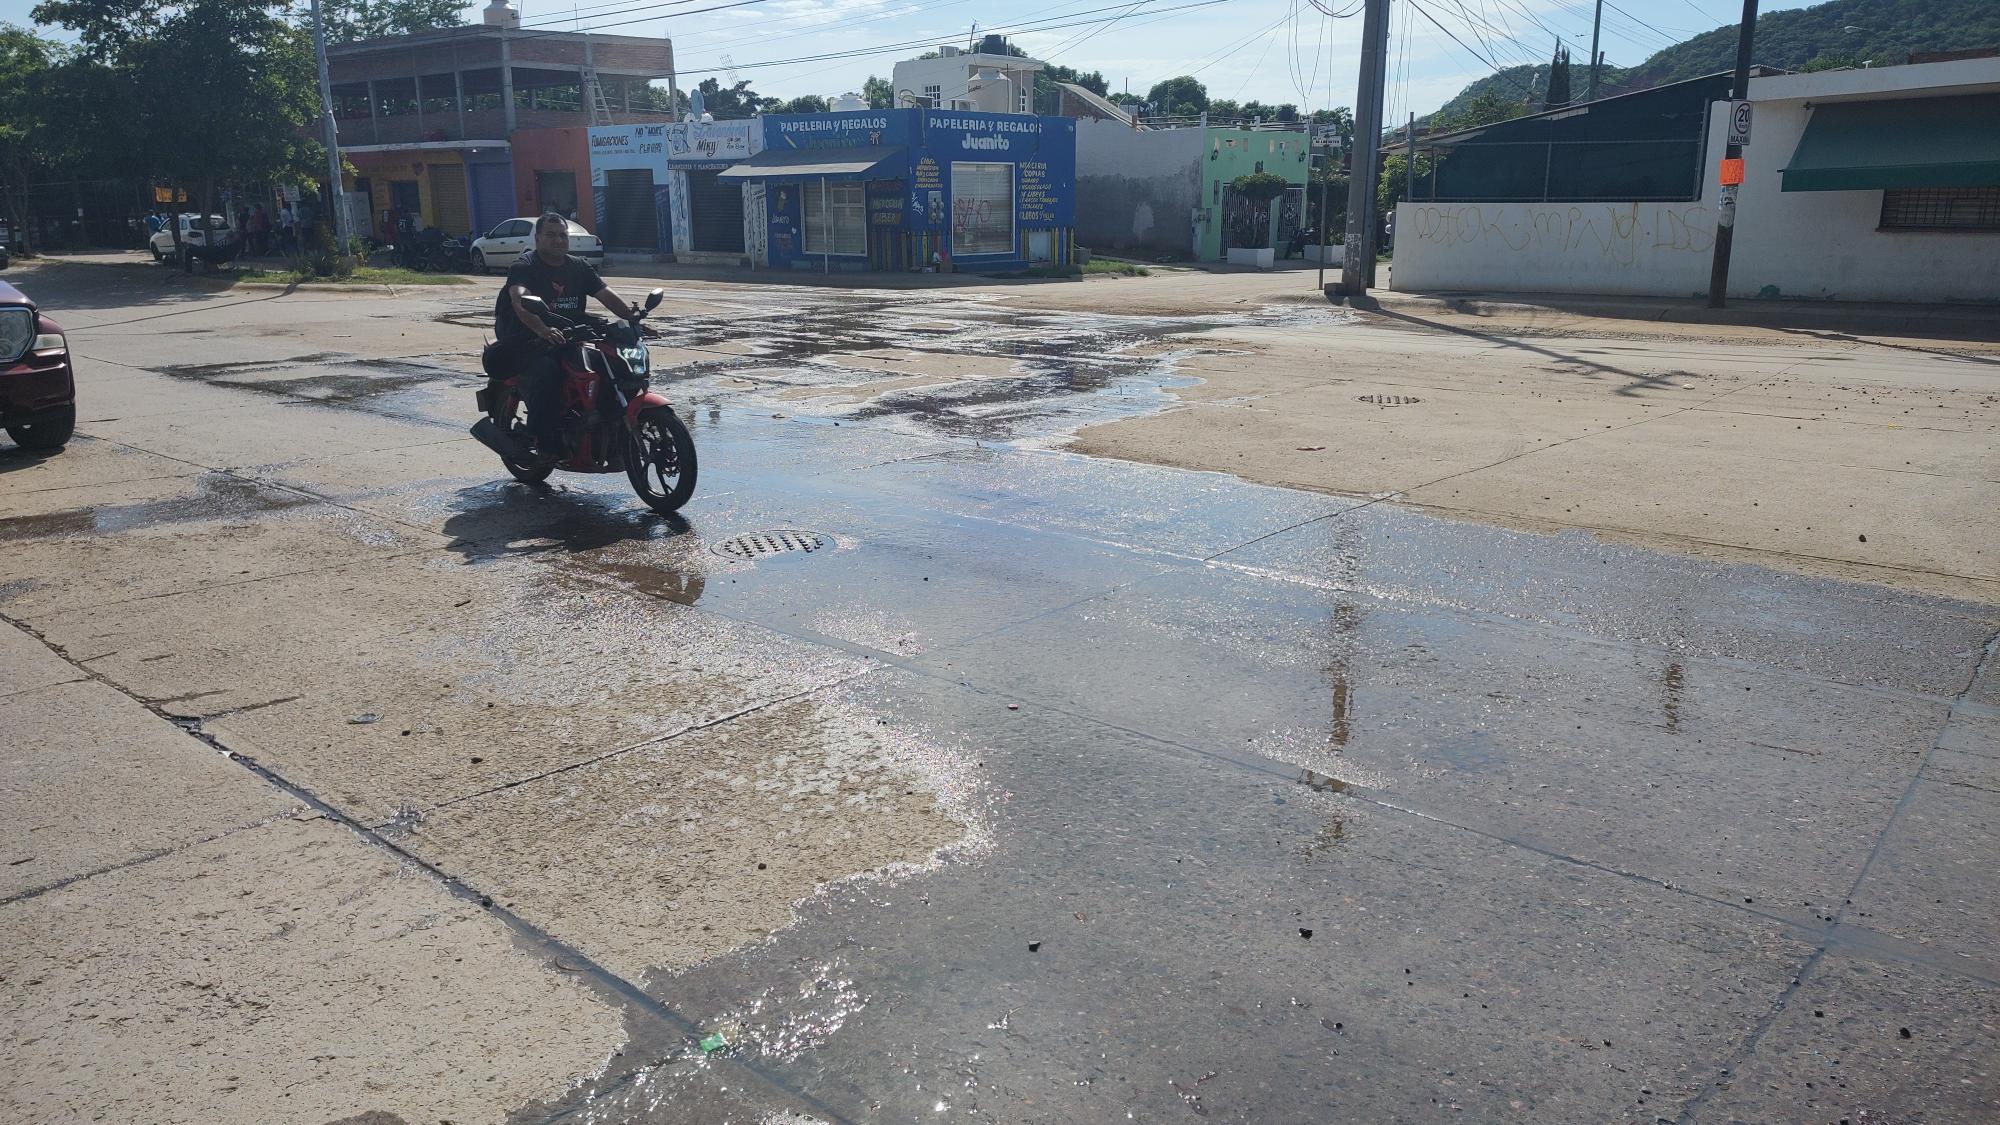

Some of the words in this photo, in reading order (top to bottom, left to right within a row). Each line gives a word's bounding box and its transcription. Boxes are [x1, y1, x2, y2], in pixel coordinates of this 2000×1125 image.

[1738, 108, 1750, 122] 20
[780, 120, 833, 132] PAPELERIA
[841, 118, 887, 130] REGALOS
[930, 117, 987, 131] PAPELERIA
[997, 121, 1042, 134] REGALOS
[962, 132, 1010, 151] Juanito
[1024, 170, 1046, 178] COPIAS
